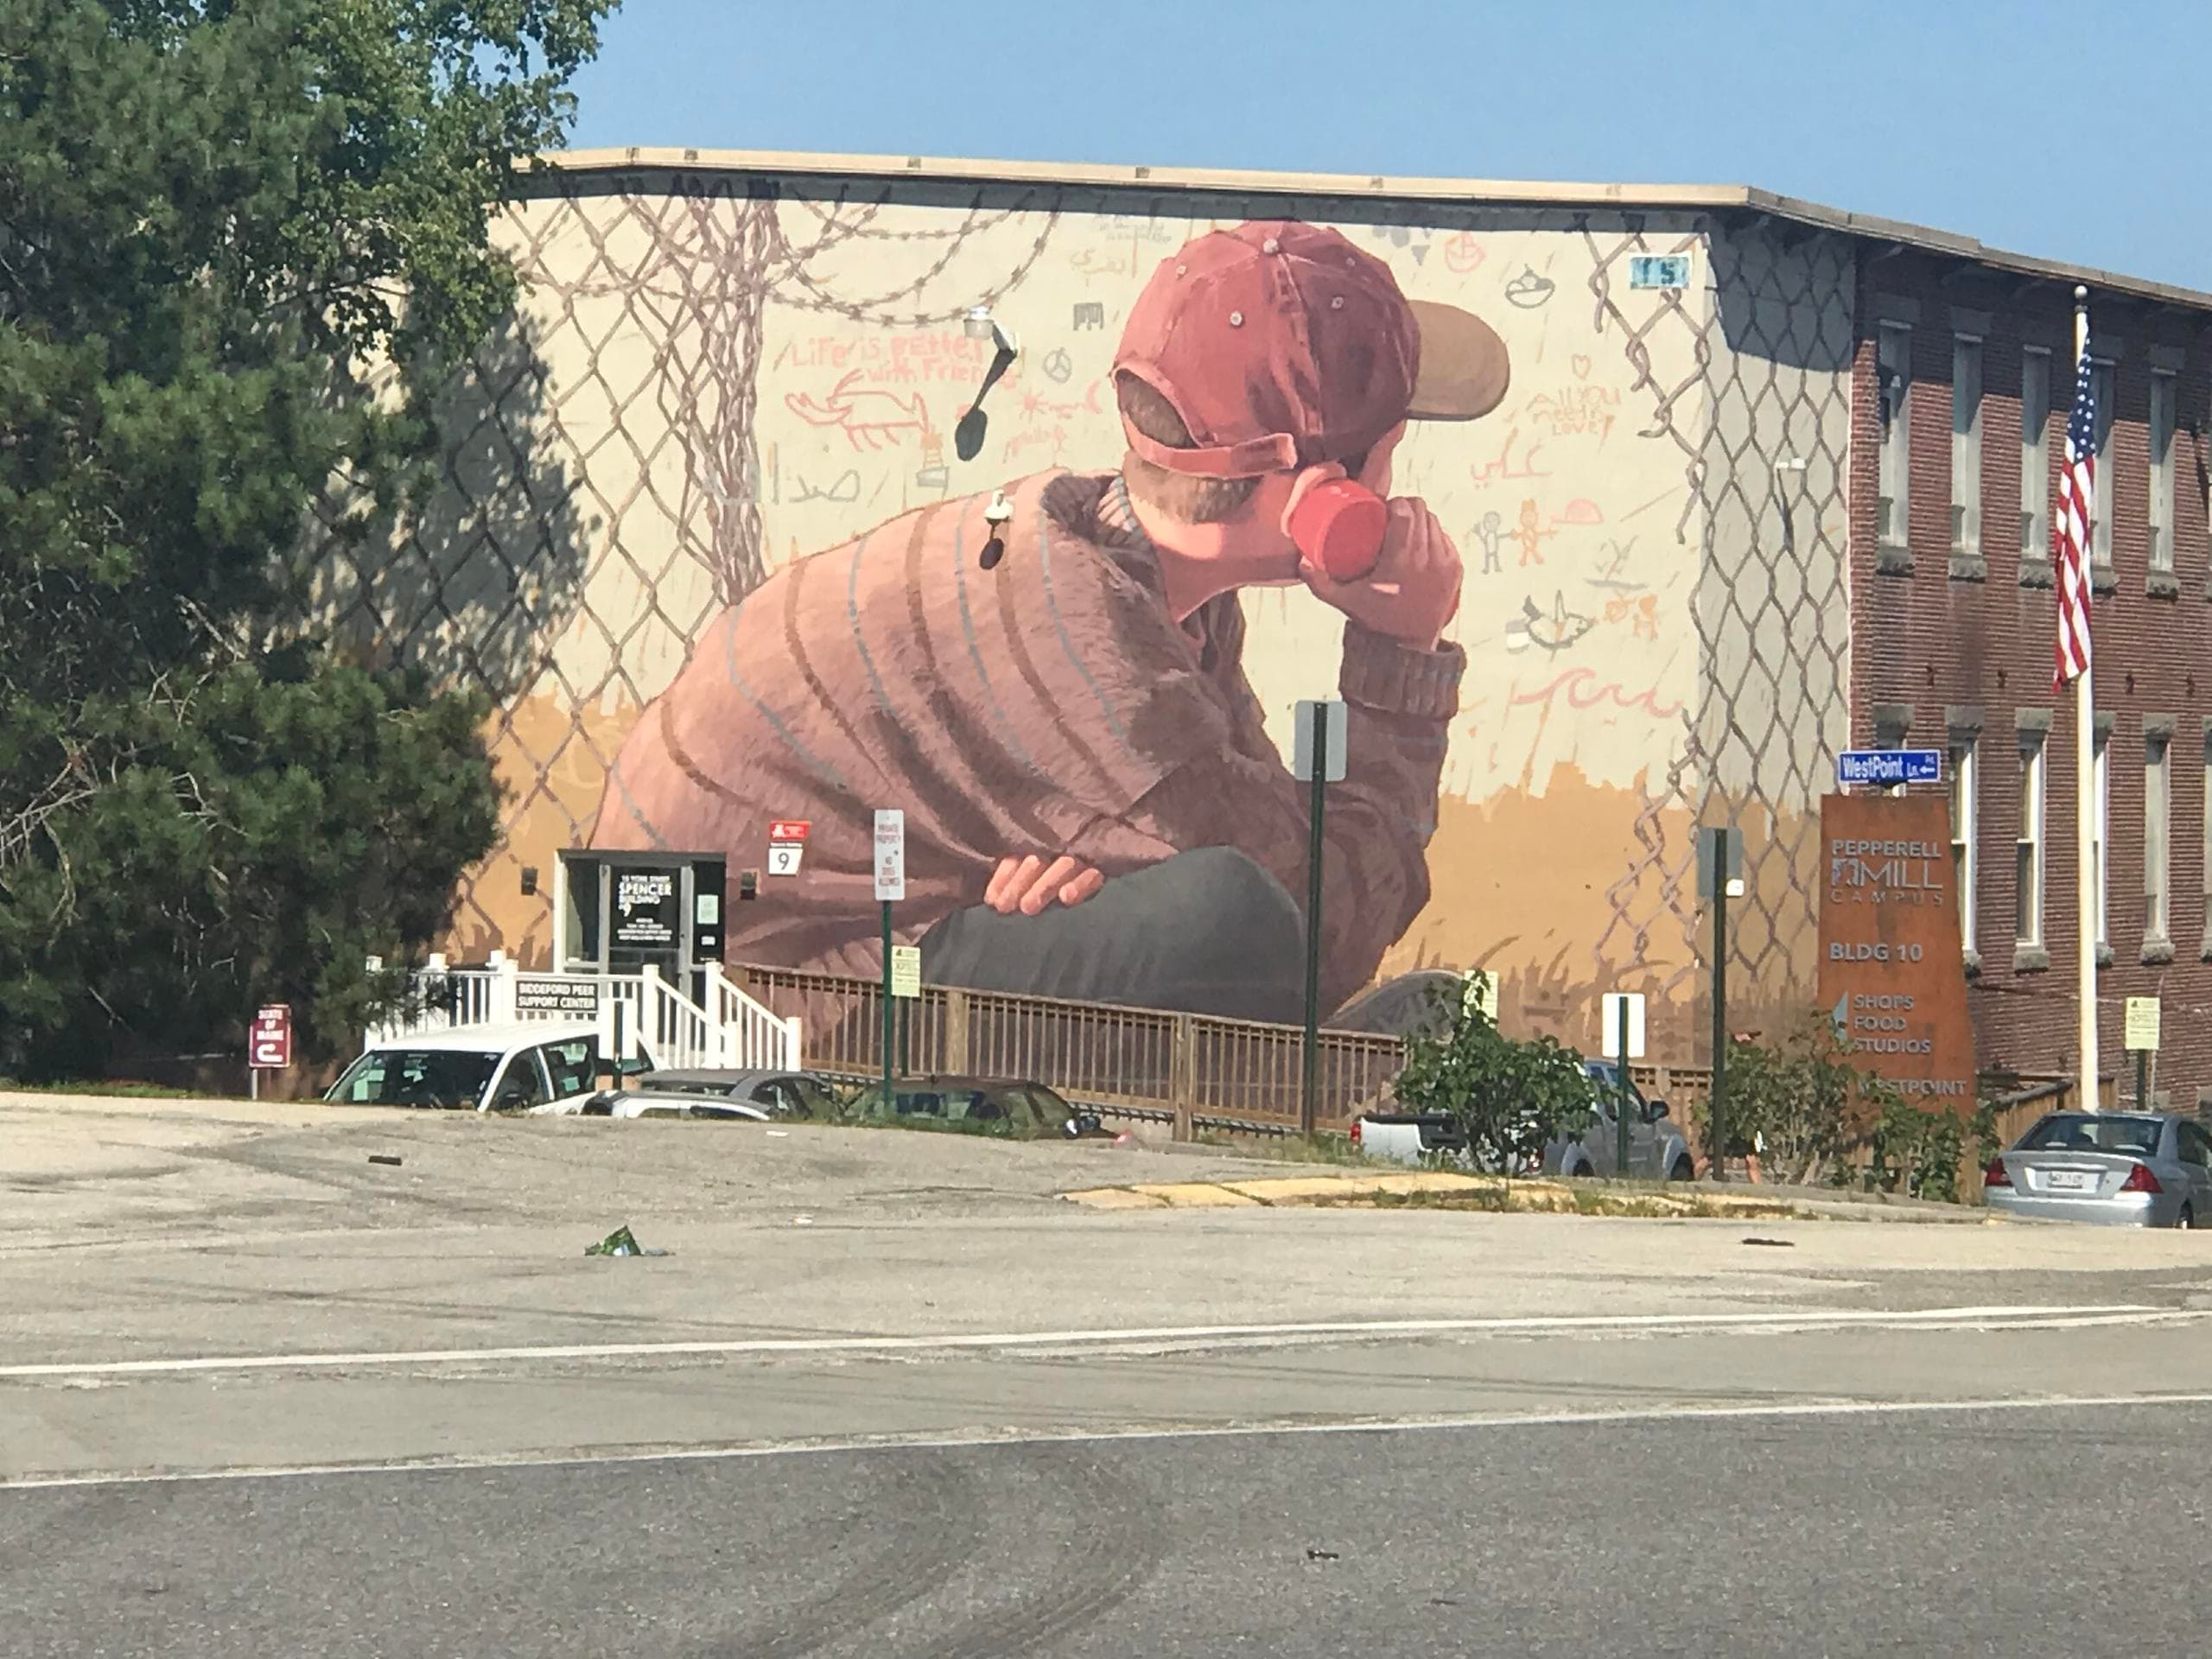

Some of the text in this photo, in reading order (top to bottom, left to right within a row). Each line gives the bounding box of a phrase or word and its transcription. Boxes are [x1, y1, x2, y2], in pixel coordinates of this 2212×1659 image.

[1842, 755, 1904, 778] WestPoint
[1831, 839, 1942, 858] PEPPERELL
[778, 852, 790, 870] 9
[619, 882, 671, 896] SPENCER
[1830, 888, 1943, 906] CAMPUS
[1829, 943, 1923, 963] BLDG 10
[572, 985, 595, 995] PEER
[518, 995, 595, 1008] SUPPORT CENTER
[1853, 994, 1915, 1010] SHOPS
[1854, 1015, 1907, 1032] FOOD
[1853, 1039, 1932, 1054] STUDIOS
